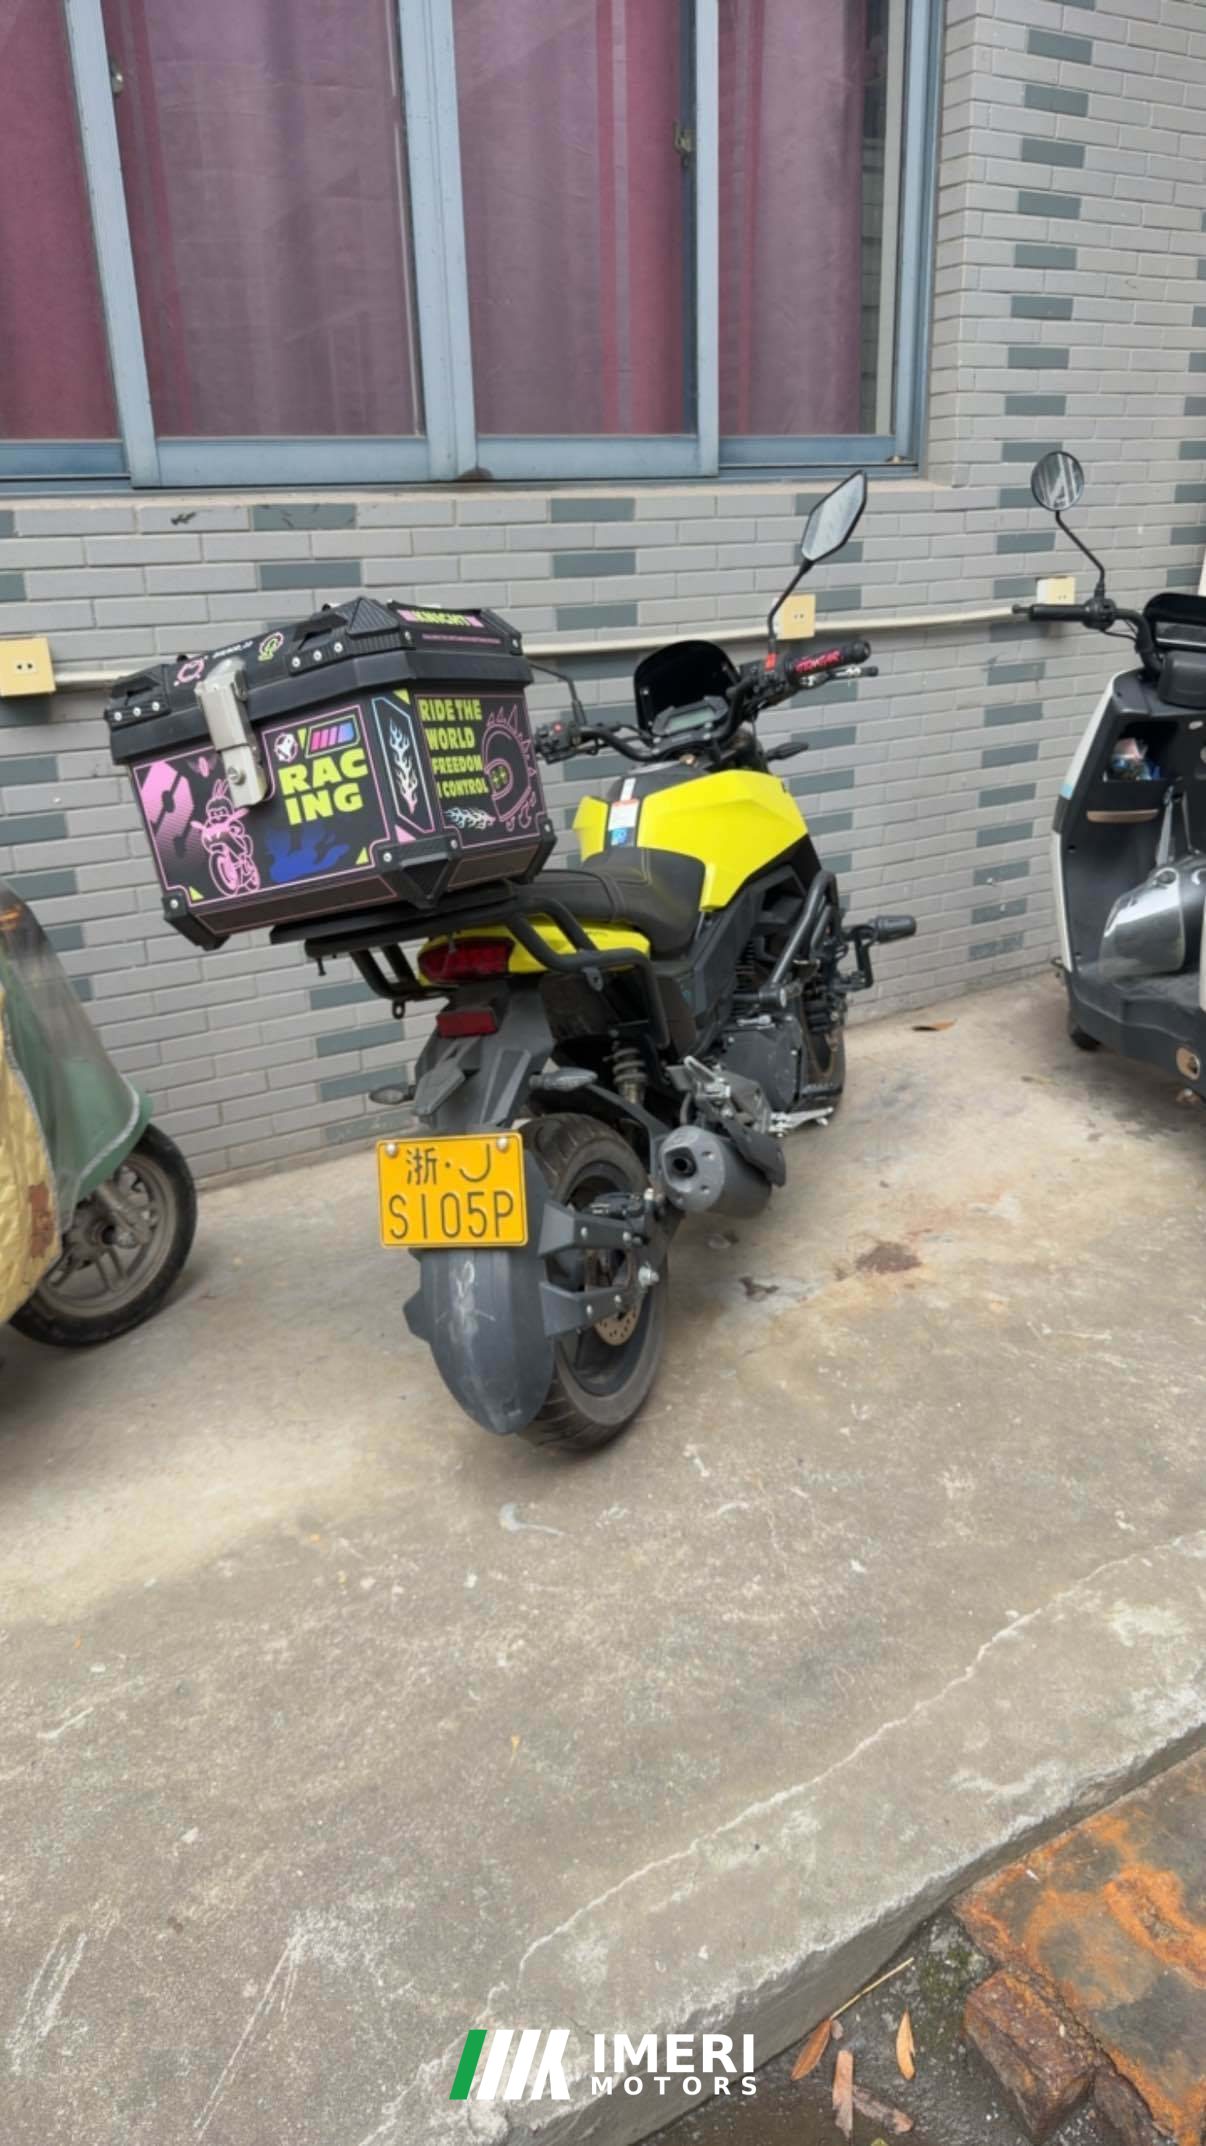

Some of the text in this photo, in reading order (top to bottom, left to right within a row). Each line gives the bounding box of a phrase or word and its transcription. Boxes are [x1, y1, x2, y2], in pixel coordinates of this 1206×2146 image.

[418, 698, 483, 721] RIDE THE
[425, 727, 476, 751] WORLD
[278, 748, 369, 796] RAC
[441, 777, 489, 798] CONTROL
[285, 782, 364, 826] ING
[388, 1190, 514, 1240] S105P
